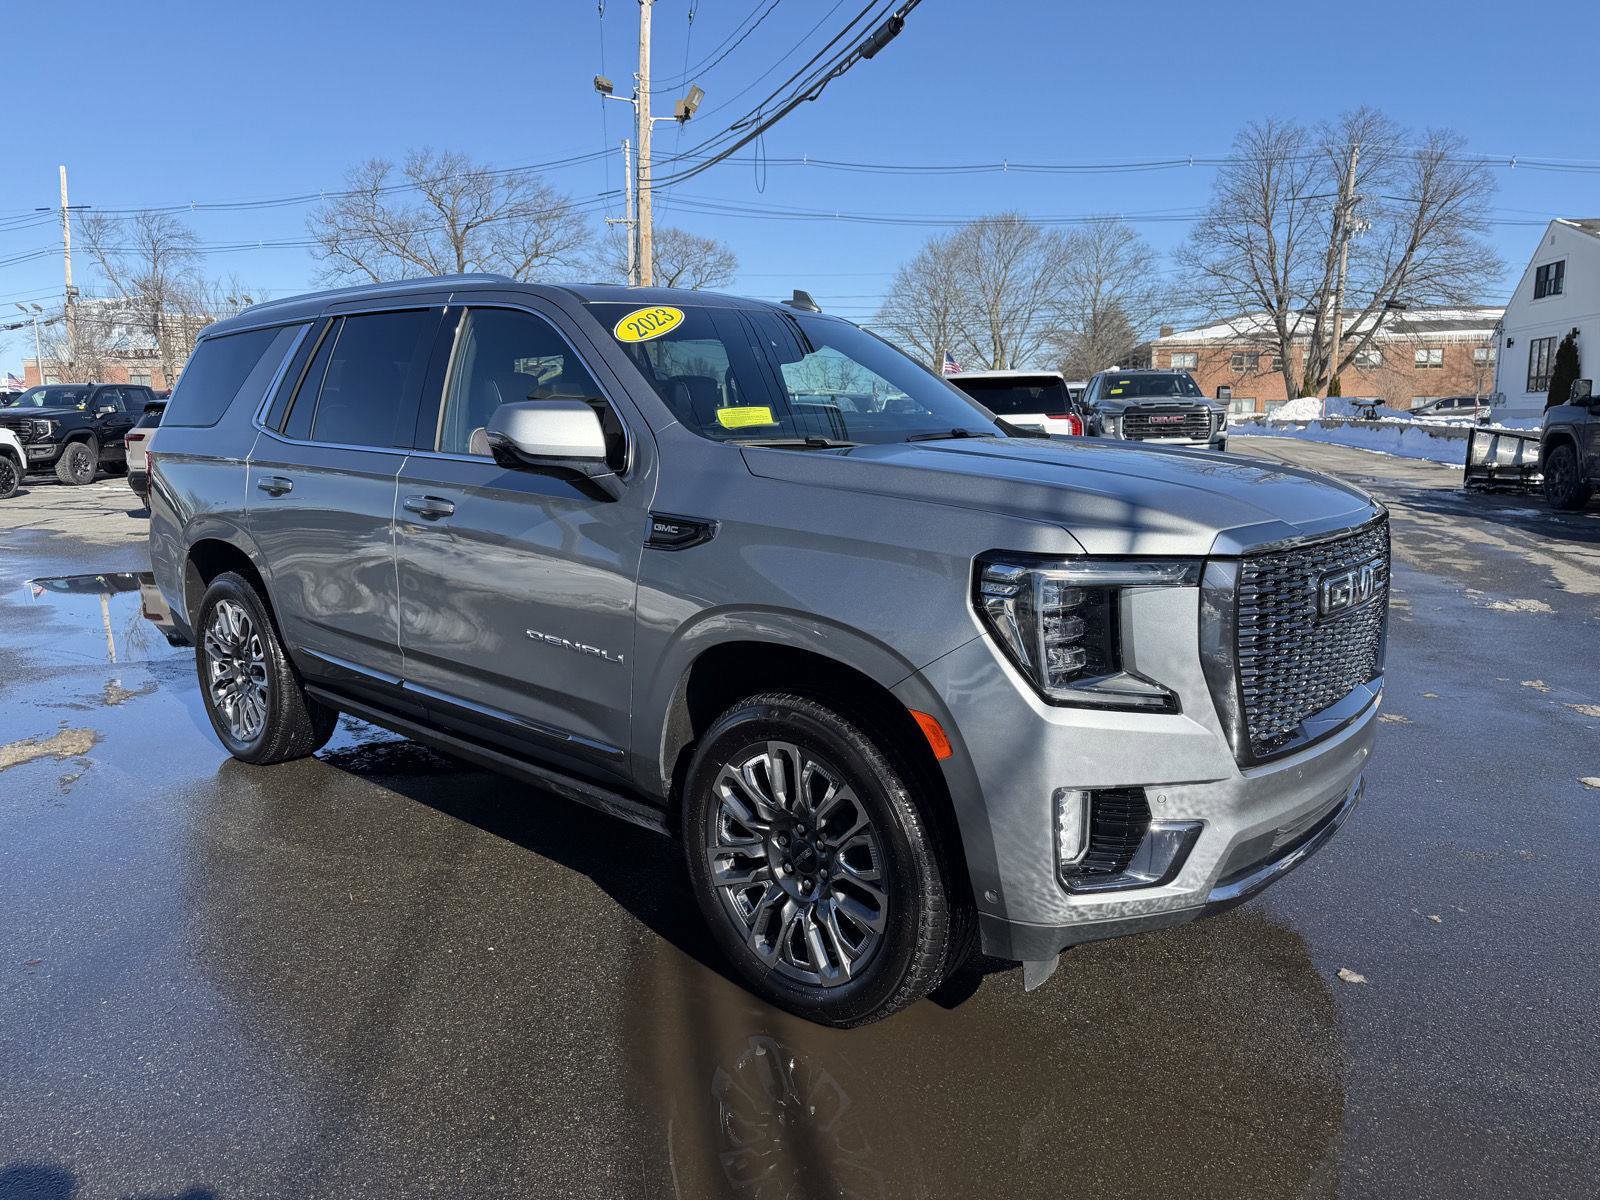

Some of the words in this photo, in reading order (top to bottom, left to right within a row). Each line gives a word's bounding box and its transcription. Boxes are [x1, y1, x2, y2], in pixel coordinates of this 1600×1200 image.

[626, 308, 675, 338] 2023
[1151, 415, 1185, 425] GMC
[654, 523, 679, 534] GMC
[1323, 558, 1385, 615] GMC
[526, 628, 624, 664] DENALI
